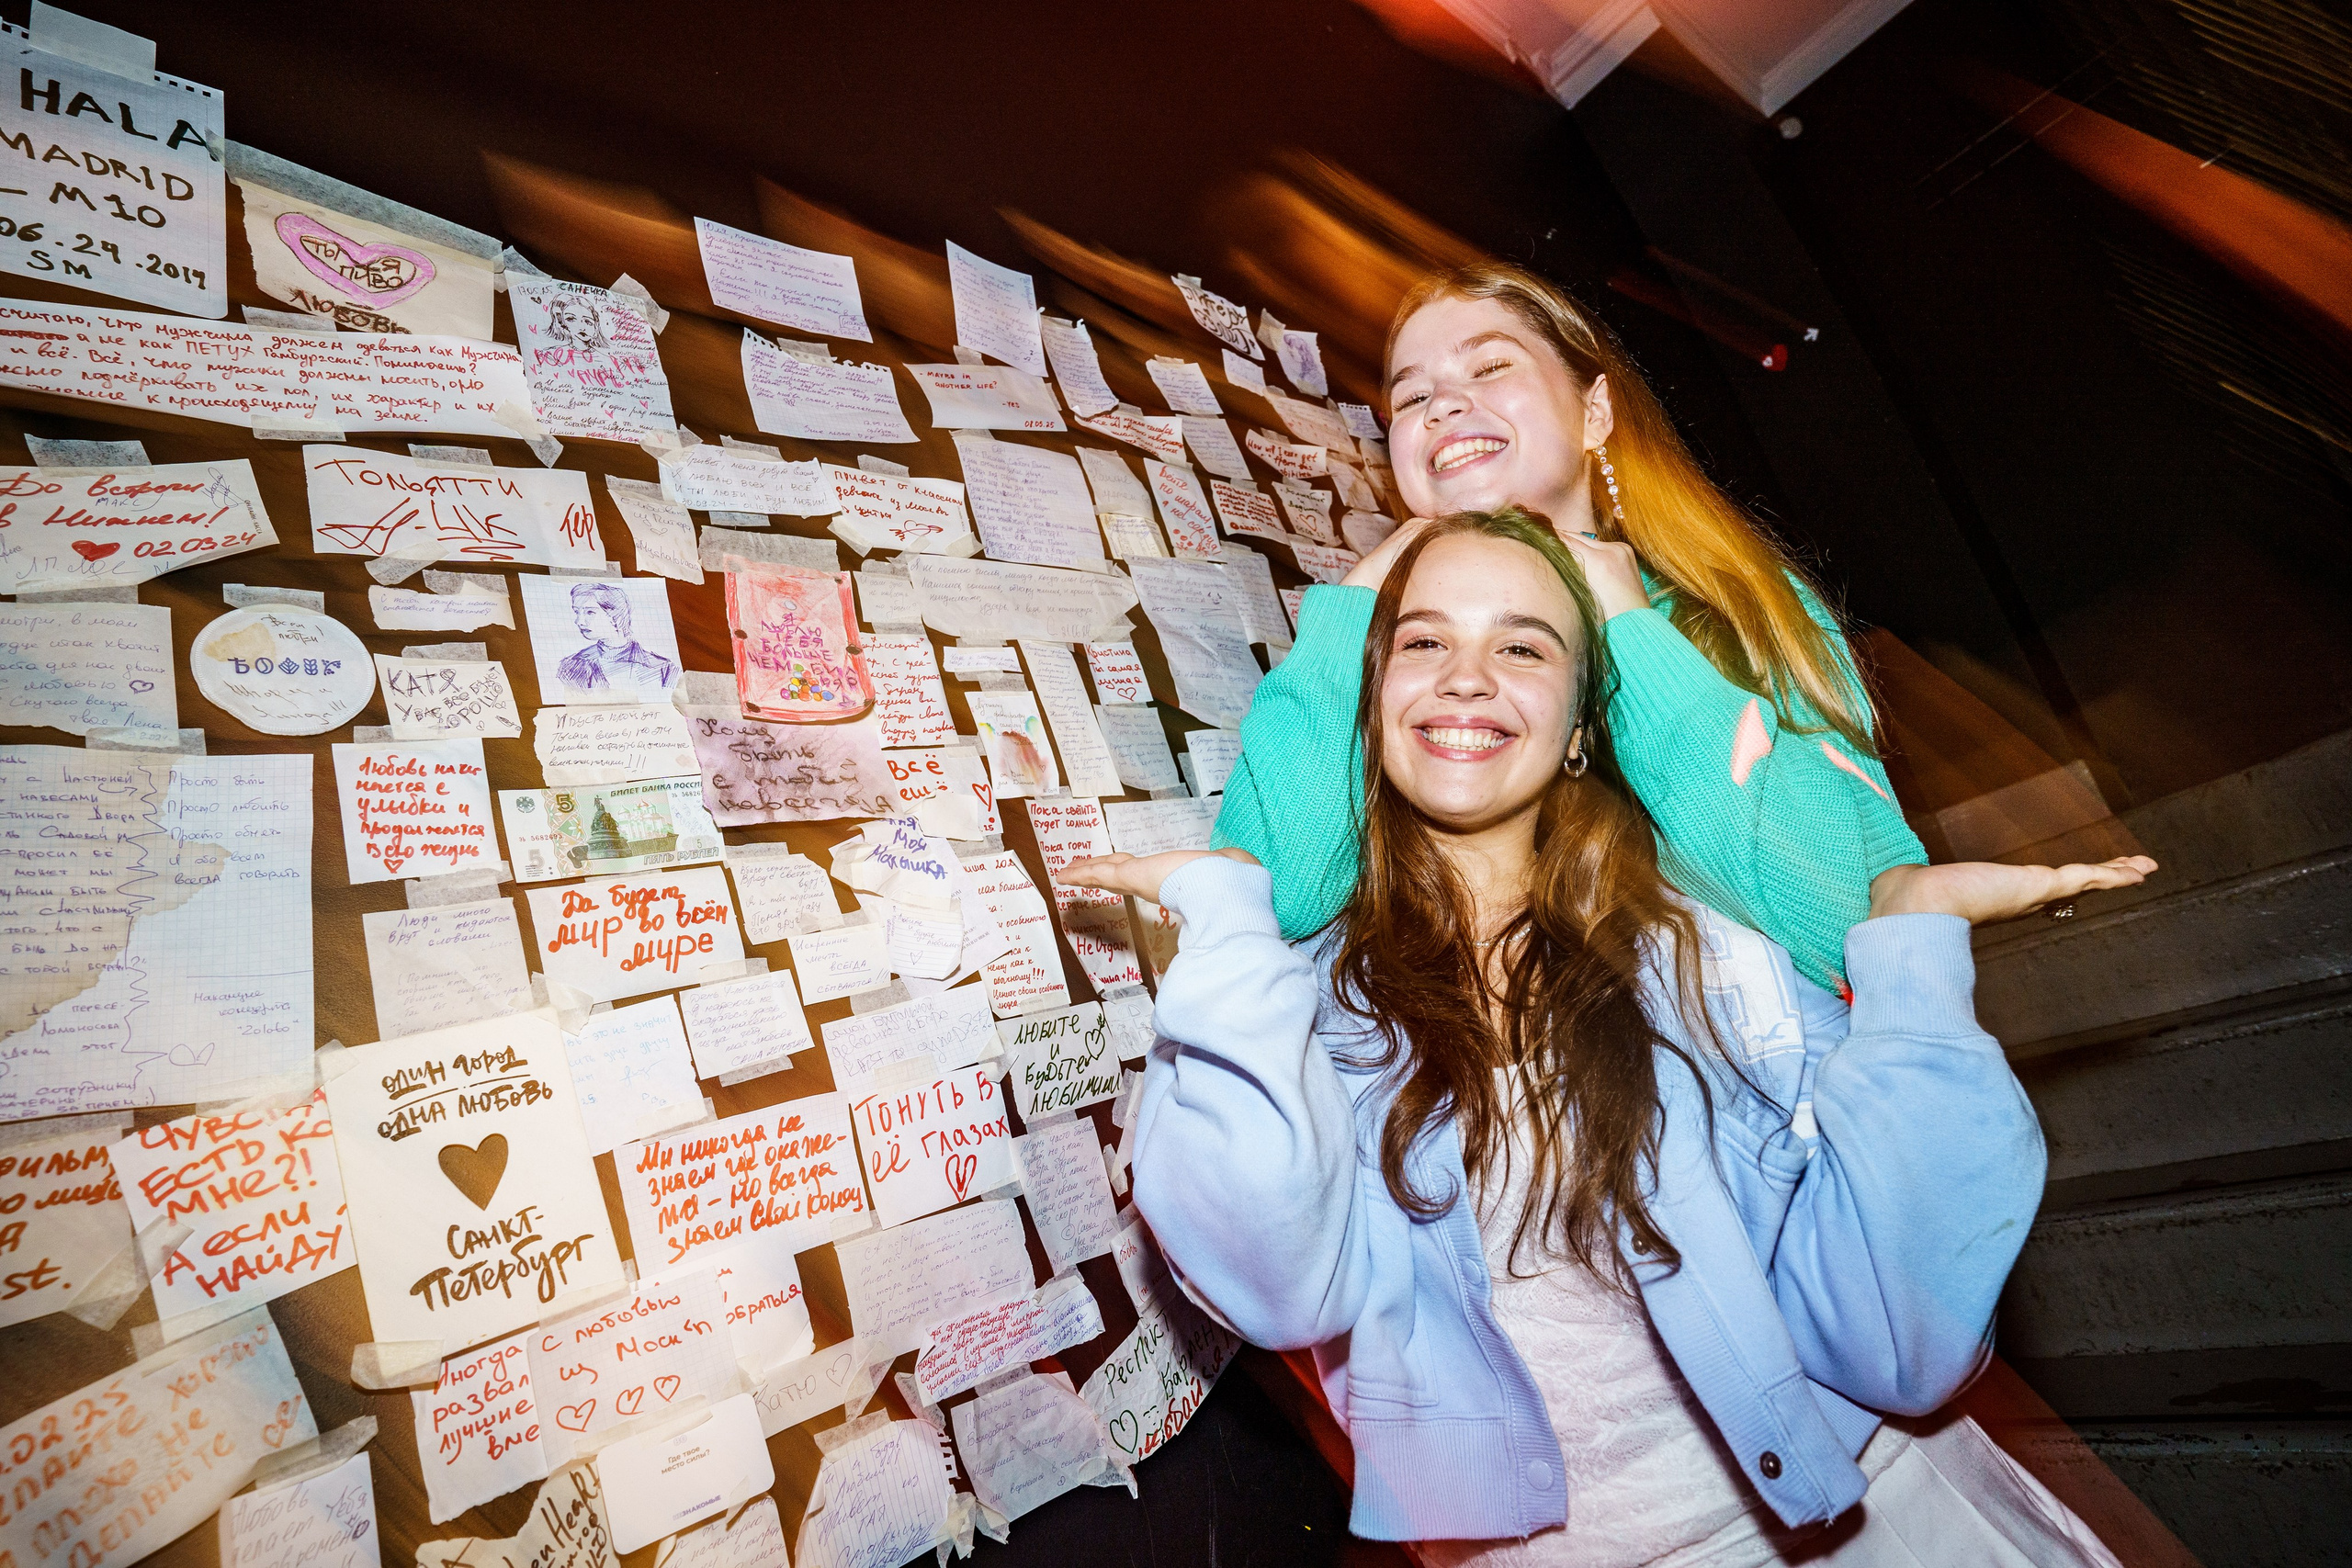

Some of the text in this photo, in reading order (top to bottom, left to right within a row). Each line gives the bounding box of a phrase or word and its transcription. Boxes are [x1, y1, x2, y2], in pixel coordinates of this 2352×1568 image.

[19, 67, 219, 162] HALA
[0, 128, 195, 201] MADRID
[49, 182, 166, 229] M10
[98, 316, 142, 331] что
[271, 335, 343, 351] должен
[429, 345, 453, 357] как
[98, 335, 127, 347] не
[140, 338, 173, 350] как
[186, 341, 254, 361] ПЕТУХ
[143, 356, 192, 371] что
[207, 363, 286, 380] мужики
[236, 381, 268, 392] их
[331, 392, 353, 402] их
[367, 393, 442, 412] характер
[477, 401, 497, 413] их
[334, 405, 362, 417] на
[0, 472, 205, 499] До встречи
[314, 458, 523, 499] ТОЛЬЯТТИ
[42, 505, 230, 529] Нижнем!
[1087, 645, 1133, 666] Кристина
[1108, 664, 1142, 674] самая
[387, 668, 459, 696] КАТЯ
[359, 755, 427, 777] Любовь
[888, 753, 944, 781] Всё
[610, 785, 641, 797] БИЛЕТ
[642, 783, 672, 794] БАНКА
[357, 793, 447, 821] улыбки
[1030, 804, 1063, 817] Пока
[1066, 818, 1101, 829] солнце
[421, 843, 480, 866] жизнь
[893, 829, 927, 853] Моя
[1068, 840, 1091, 852] горит
[643, 846, 720, 865] ПЯТЬ РУБЛЕЙ
[865, 844, 948, 880] Малышка
[561, 884, 686, 919] Да будет
[397, 912, 438, 930] Люди
[548, 916, 623, 958] мир
[638, 906, 664, 933] во
[619, 932, 714, 974] мире
[1077, 936, 1094, 957] Не
[1013, 1013, 1081, 1045] ЛЮБИТЕ
[382, 1061, 446, 1100] ОДИН
[378, 1079, 553, 1141] ОДНА ЛЮБОВЬ
[680, 1123, 767, 1165] никогда
[777, 1113, 805, 1139] не
[138, 1139, 265, 1207] ЕСТЬ
[647, 1162, 717, 1207] знаем
[730, 1177, 762, 1210] но
[768, 1160, 838, 1196] всегда
[667, 1215, 742, 1265] знаем
[196, 1224, 344, 1297] НАЙДУ
[439, 1399, 534, 1466] лучшие
[661, 1449, 711, 1476] место силы?
[667, 1445, 700, 1466] Где твое
